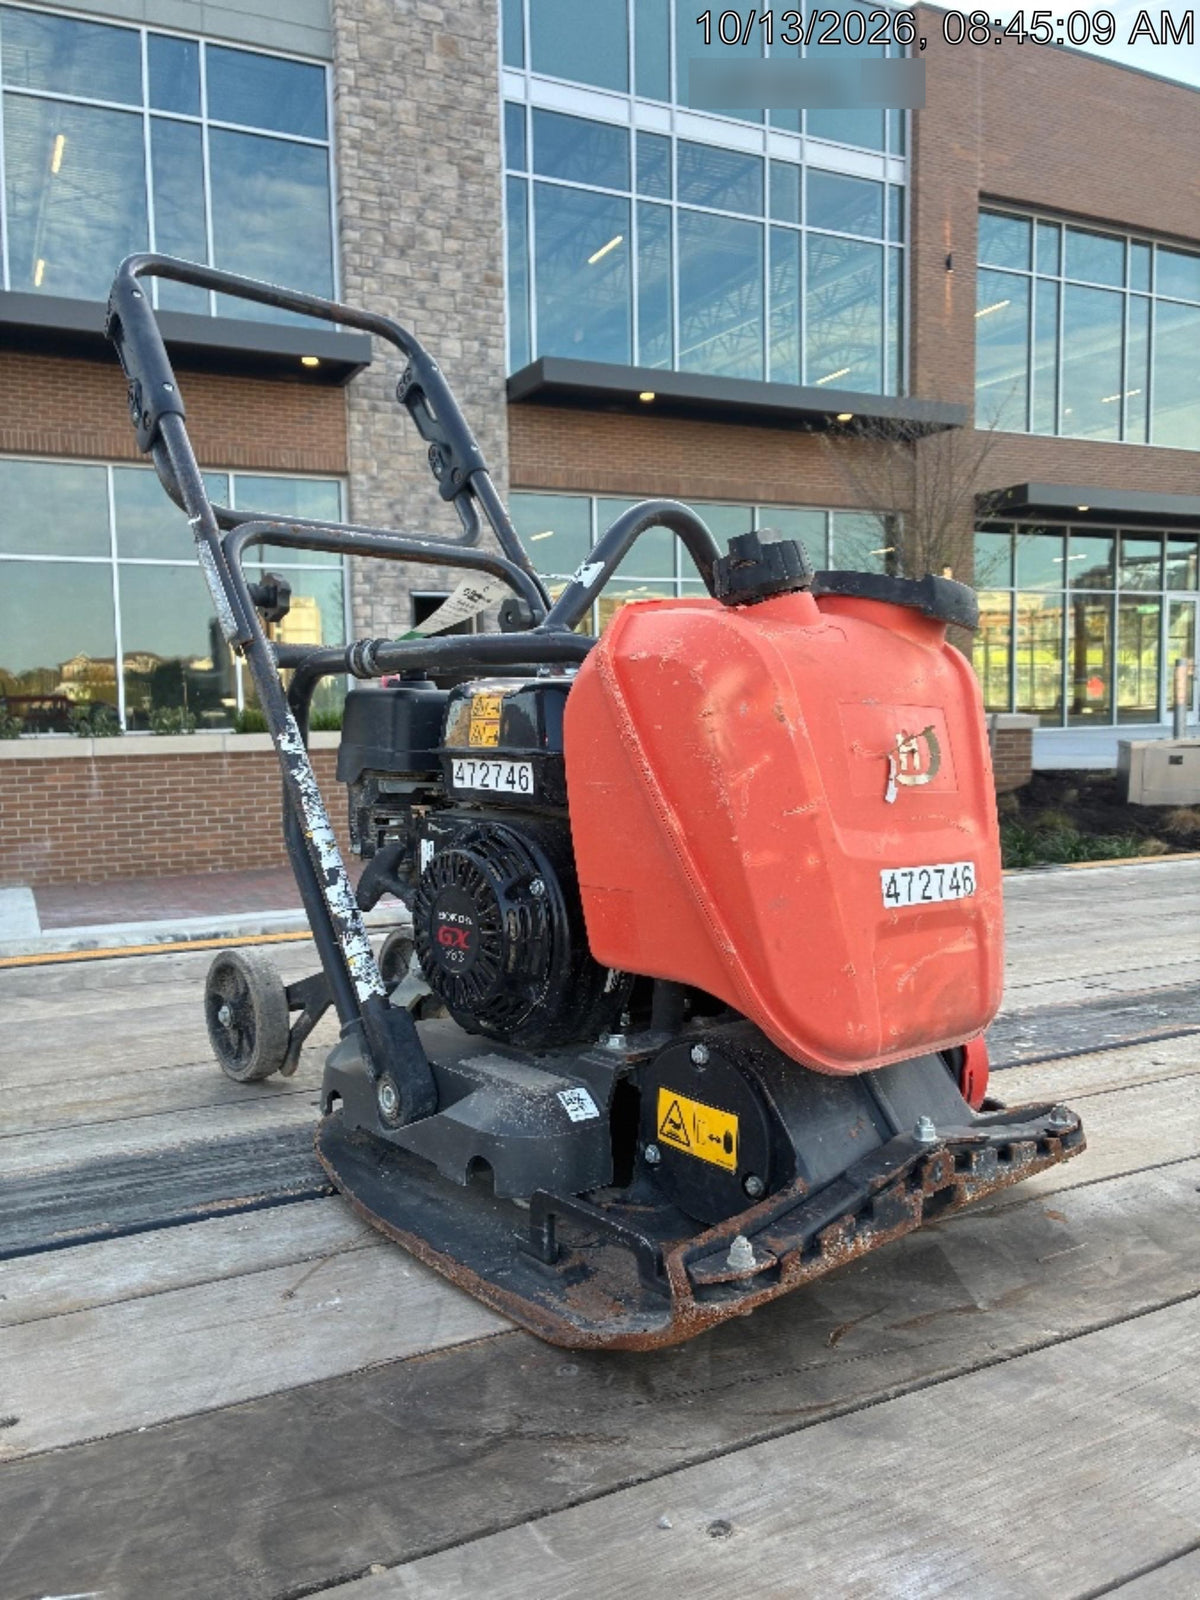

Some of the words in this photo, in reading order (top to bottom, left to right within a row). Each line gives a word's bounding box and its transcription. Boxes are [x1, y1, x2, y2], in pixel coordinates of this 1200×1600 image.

[454, 761, 531, 792] 472746
[885, 864, 974, 904] 472746
[437, 925, 471, 950] GX
